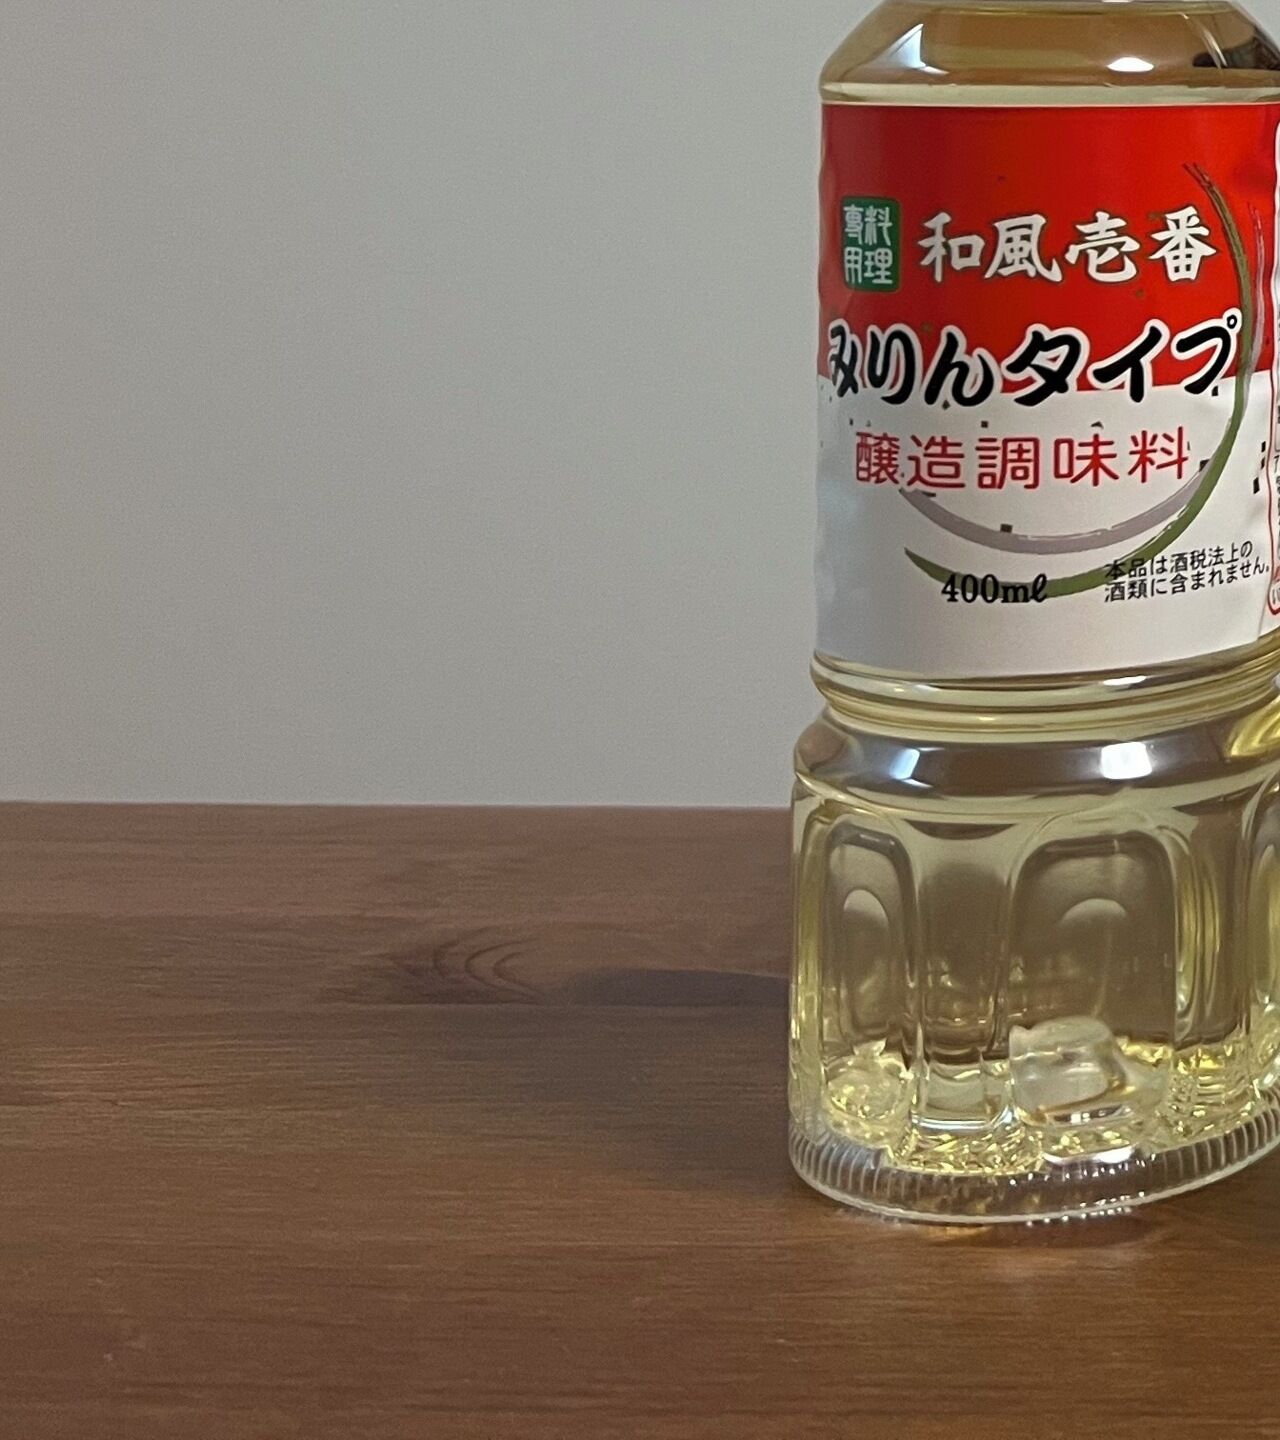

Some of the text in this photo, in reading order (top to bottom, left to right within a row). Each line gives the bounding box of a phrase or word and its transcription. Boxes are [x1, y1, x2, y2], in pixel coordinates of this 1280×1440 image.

[917, 205, 1217, 283] 和風壱番
[827, 314, 1240, 407] みりんタイプ
[855, 426, 1189, 490] 醸造調味料
[1104, 539, 1253, 581] 本品は酒税法上の
